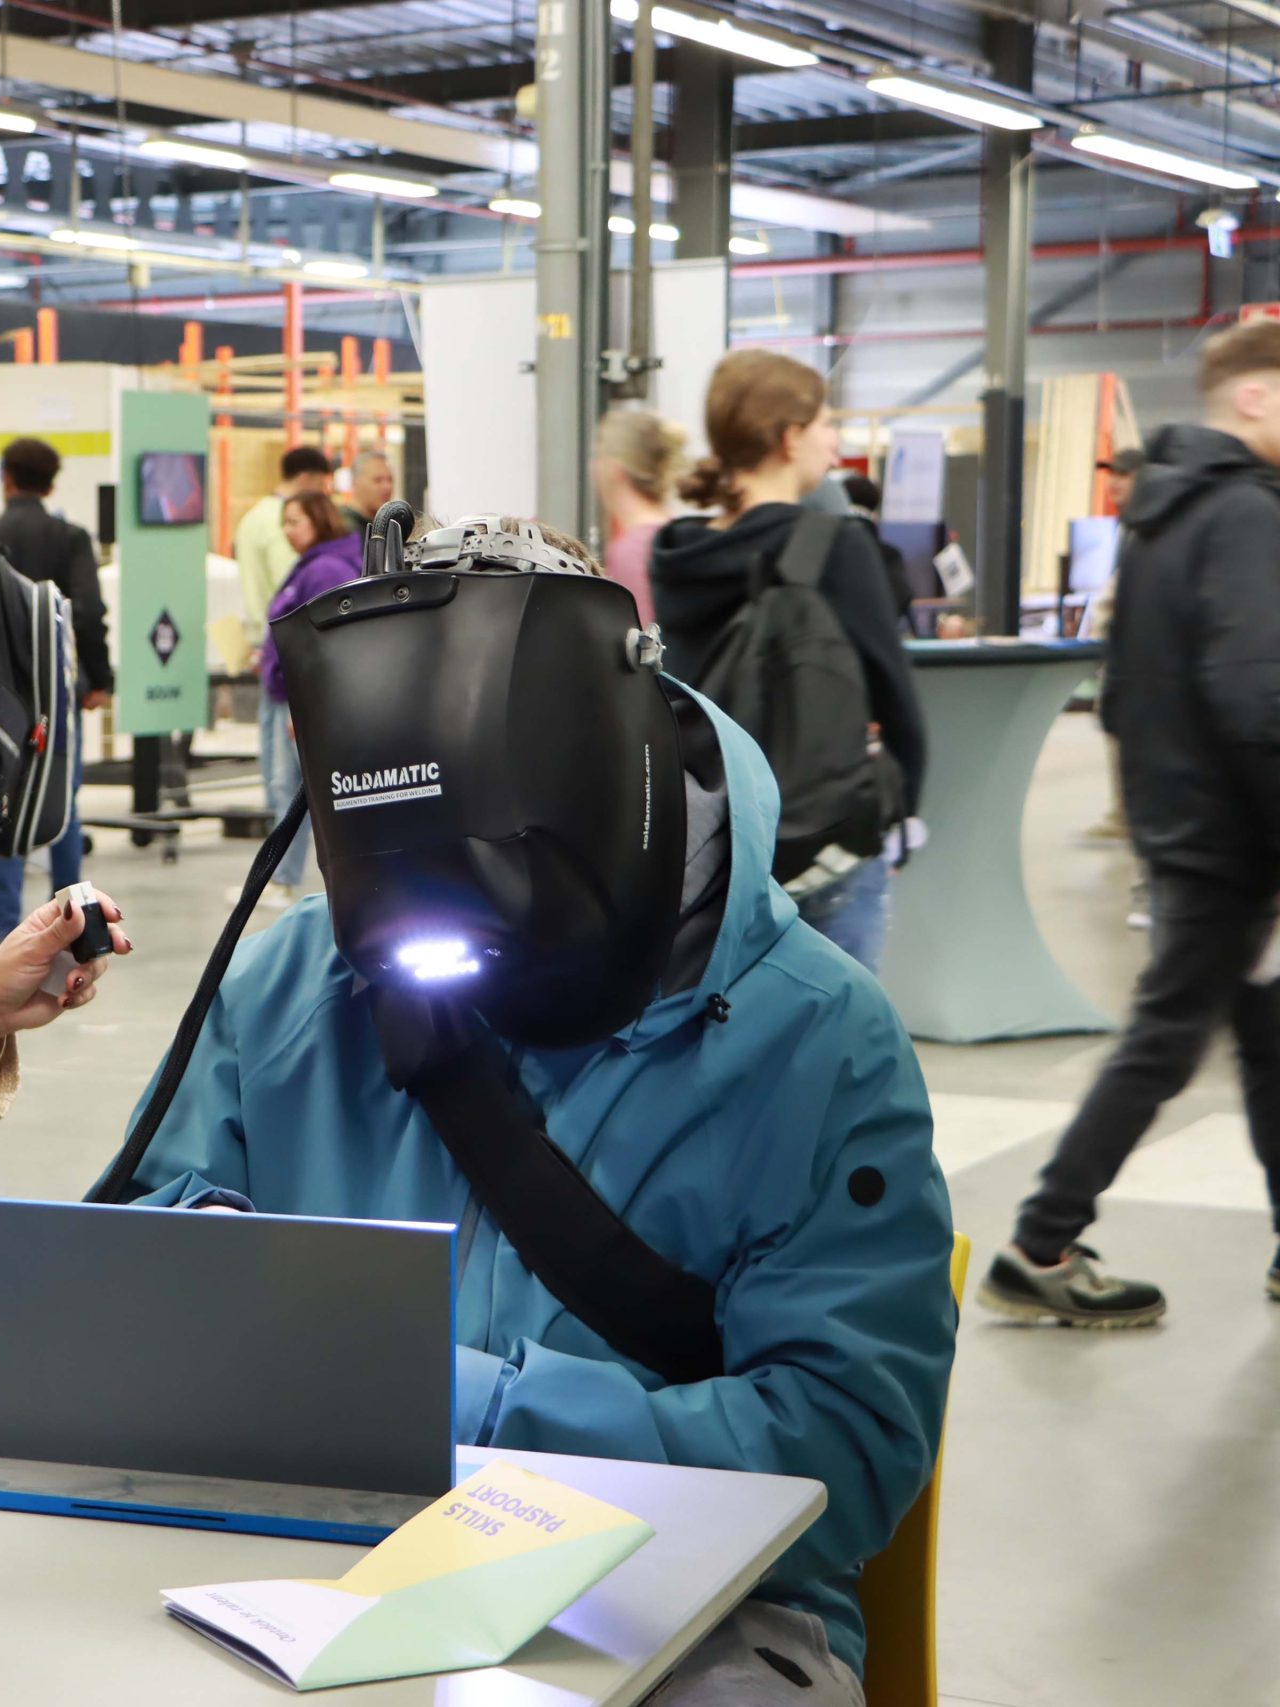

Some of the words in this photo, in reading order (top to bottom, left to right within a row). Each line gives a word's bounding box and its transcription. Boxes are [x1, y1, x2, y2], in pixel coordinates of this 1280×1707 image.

[336, 797, 368, 808] AUGMENTED
[368, 792, 396, 803] TRAINING
[396, 790, 409, 800] FOR
[409, 787, 439, 798] WELDING
[642, 743, 651, 850] soldamatic.com
[443, 1502, 505, 1536] SKILLS
[467, 1484, 566, 1533] PASPOORT
